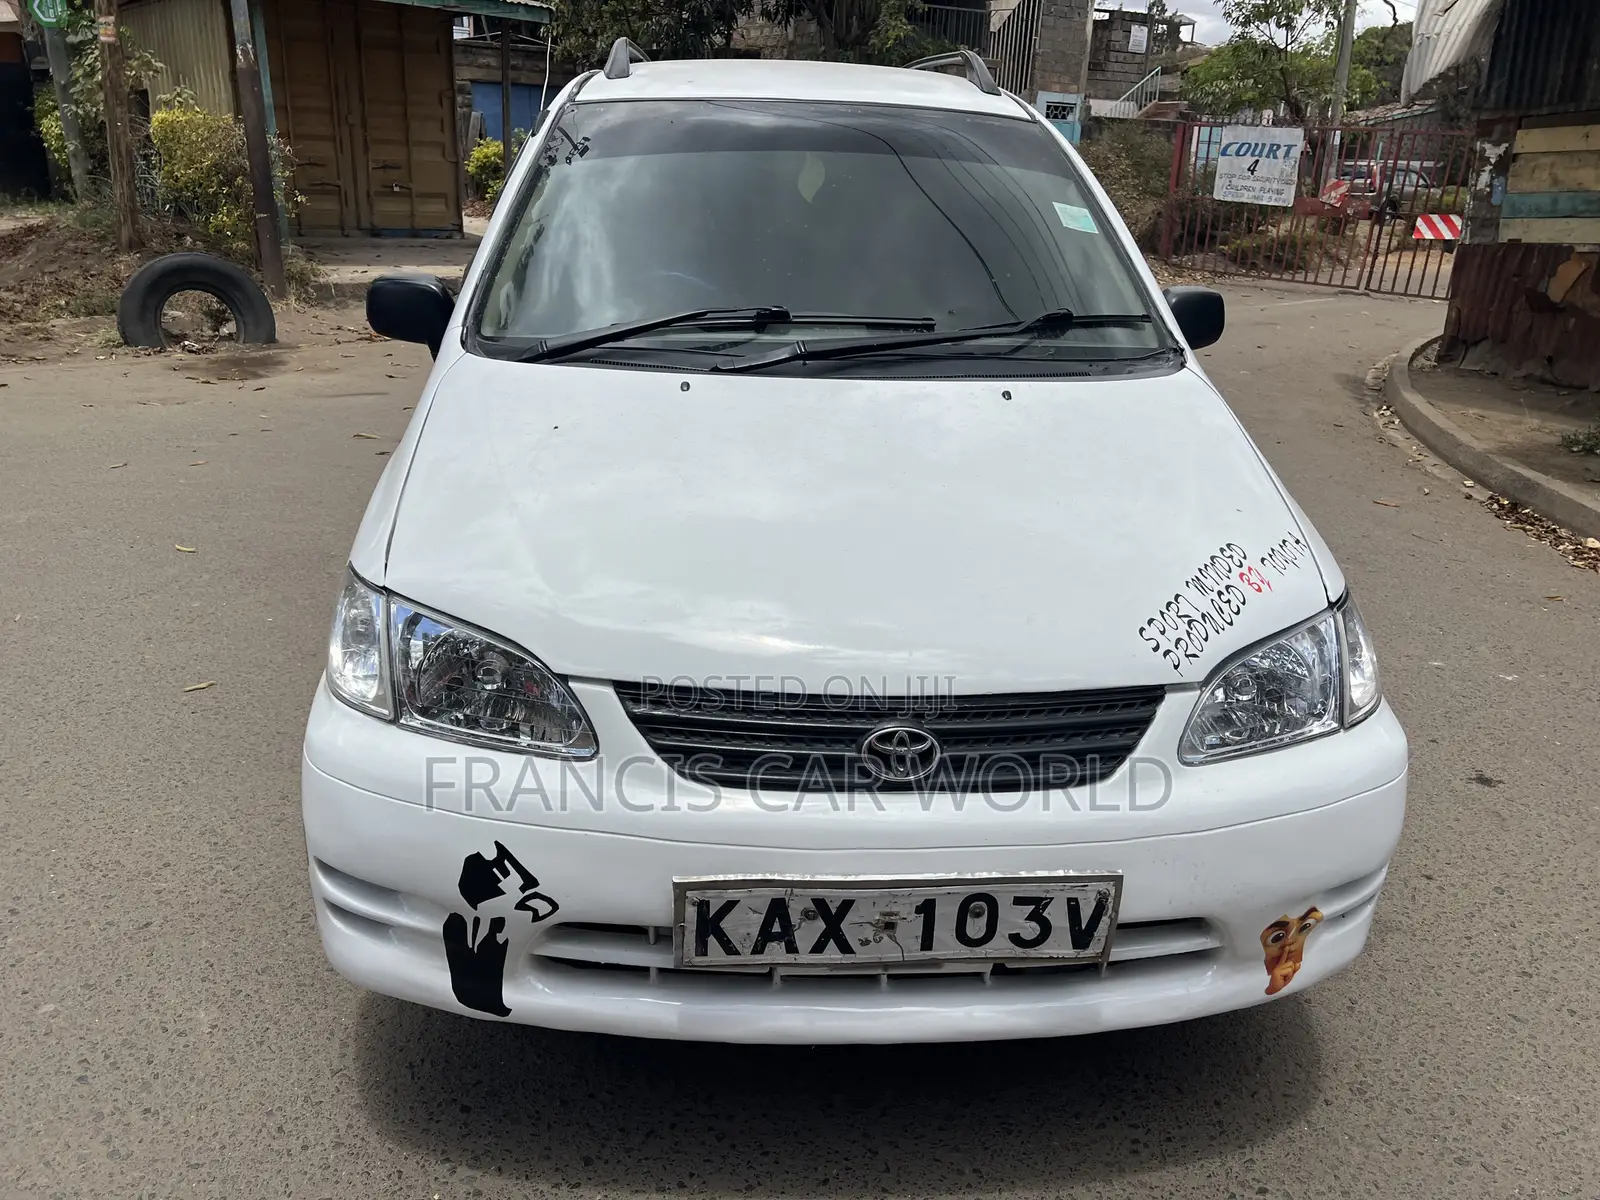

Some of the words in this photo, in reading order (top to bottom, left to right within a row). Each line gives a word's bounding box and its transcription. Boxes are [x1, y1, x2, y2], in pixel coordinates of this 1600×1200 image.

[1220, 142, 1298, 160] COURT
[1247, 159, 1260, 176] 4
[1252, 175, 1280, 184] SECURITY
[1222, 191, 1245, 199] SPEED
[1225, 182, 1257, 193] CHILDREN
[1259, 186, 1285, 196] PLAYING
[1138, 593, 1201, 653] SPORT
[1185, 542, 1248, 597] MINDED
[1162, 584, 1247, 678] PRODUCED
[1238, 565, 1273, 594] BY
[1260, 531, 1308, 577] TOYOTA
[695, 897, 857, 957] KAX
[908, 892, 1107, 952] 103V
